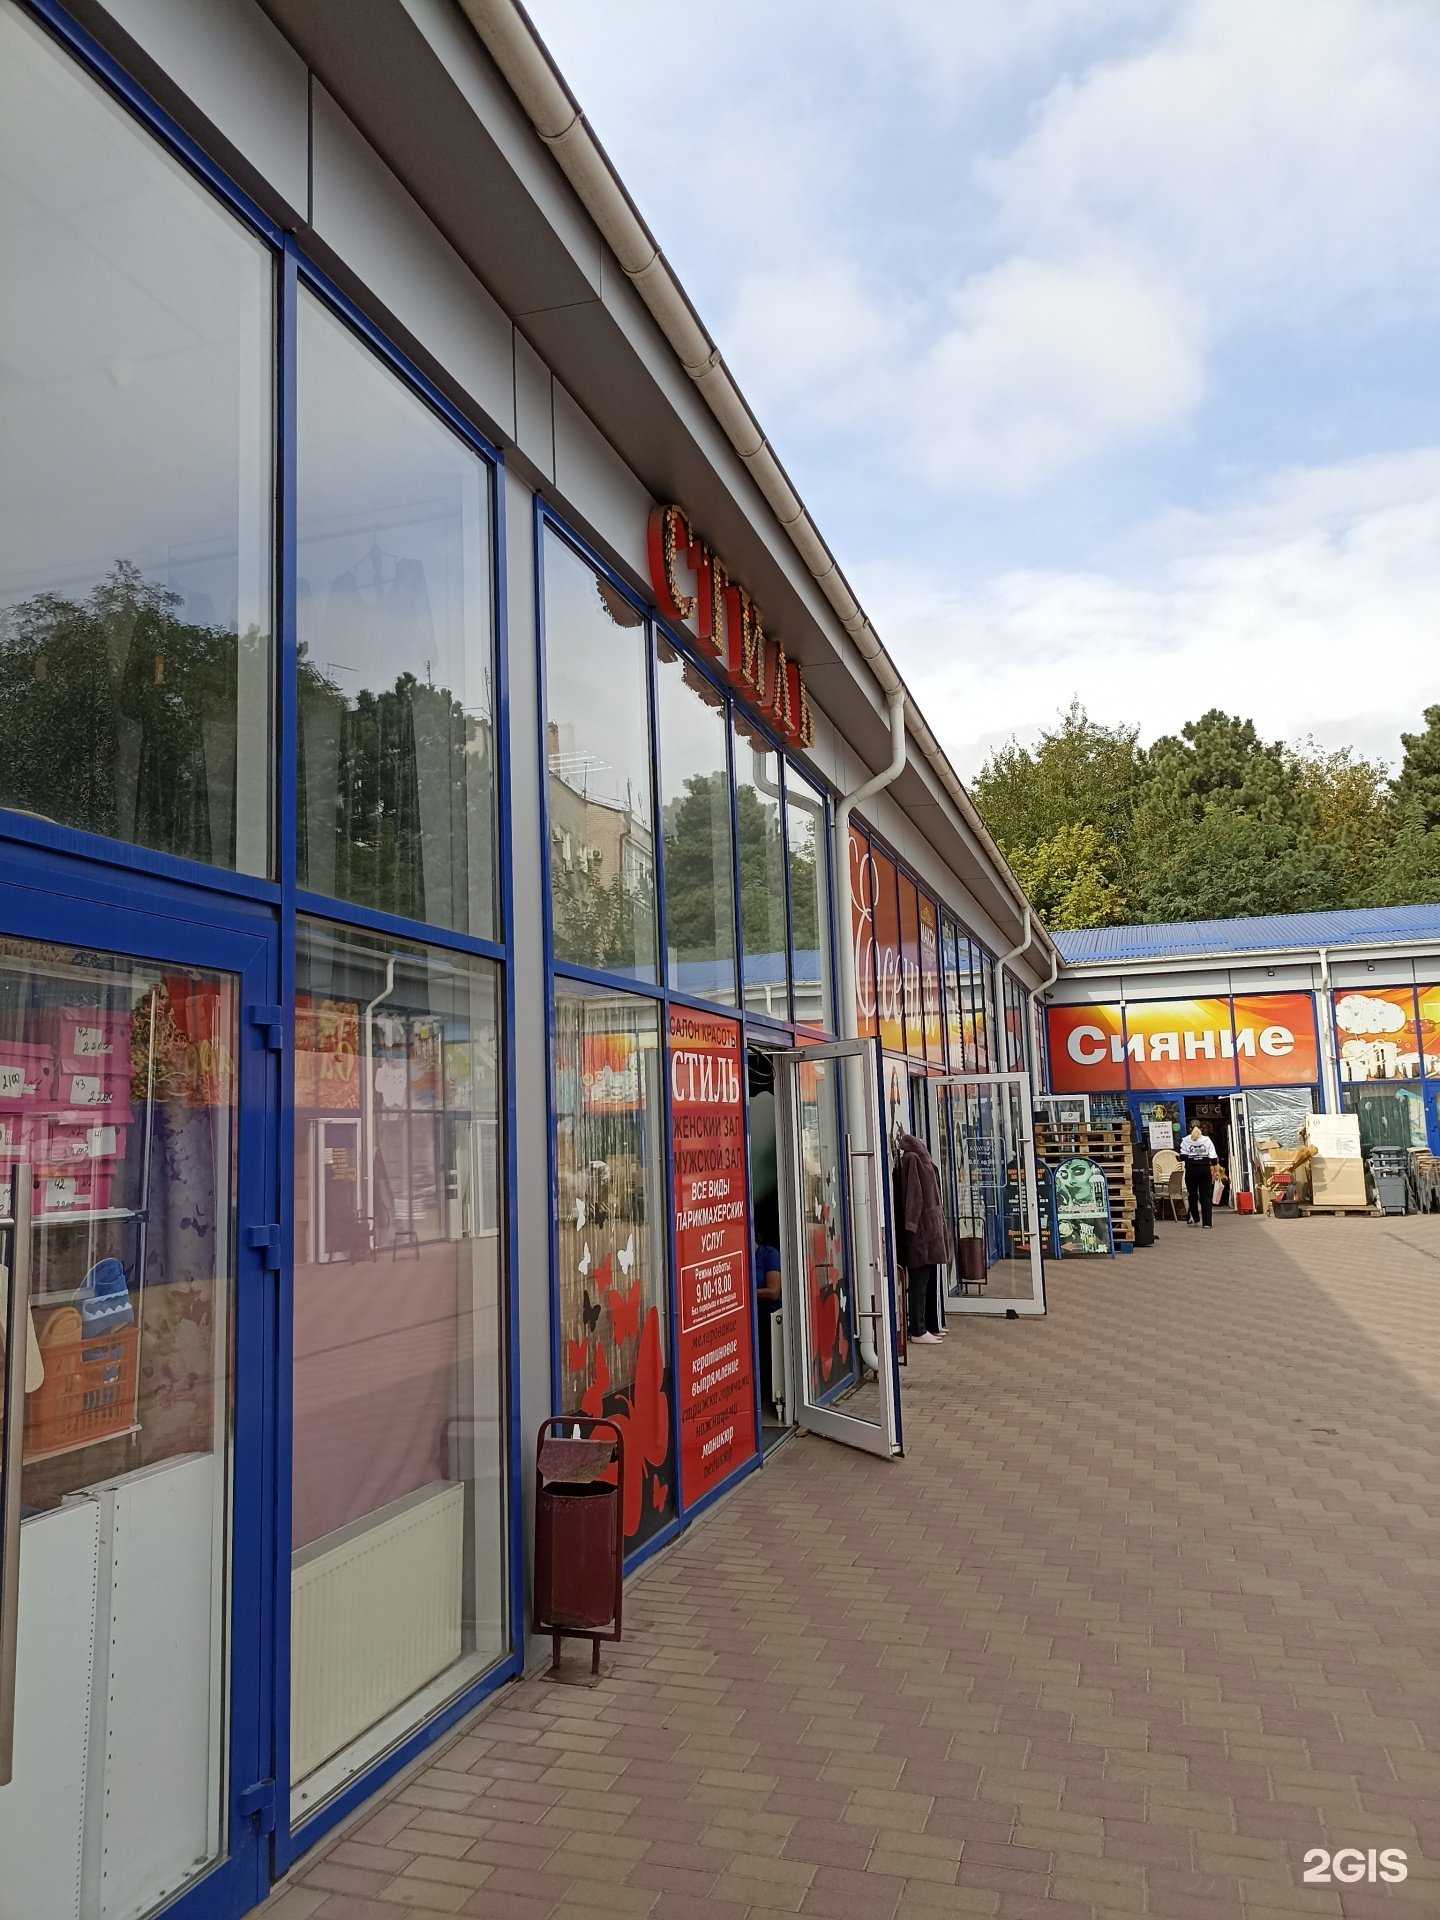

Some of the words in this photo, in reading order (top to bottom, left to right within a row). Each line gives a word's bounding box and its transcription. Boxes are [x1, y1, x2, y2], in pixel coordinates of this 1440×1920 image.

[670, 1016, 699, 1039] САЛОН
[1067, 1024, 1295, 1065] Сияние
[671, 1051, 740, 1104] СТИЛЬ
[673, 1113, 721, 1138] ЖЕНСКИЙ
[723, 1115, 740, 1137] ЗАЛ
[673, 1144, 722, 1174] МУЖСКОЙ
[724, 1146, 742, 1168] ЗАЛ
[691, 1180, 707, 1200] ВСЕ
[708, 1178, 730, 1200] ВИДЫ
[676, 1200, 744, 1232] ПАРИКМАХЕРСКИХ
[701, 1229, 726, 1253] УСЛУГ
[696, 1273, 732, 1303] 9.00-18.00
[692, 1339, 738, 1375] кератиновое
[691, 1359, 739, 1397] выпрямление
[701, 1425, 734, 1460] маникюр
